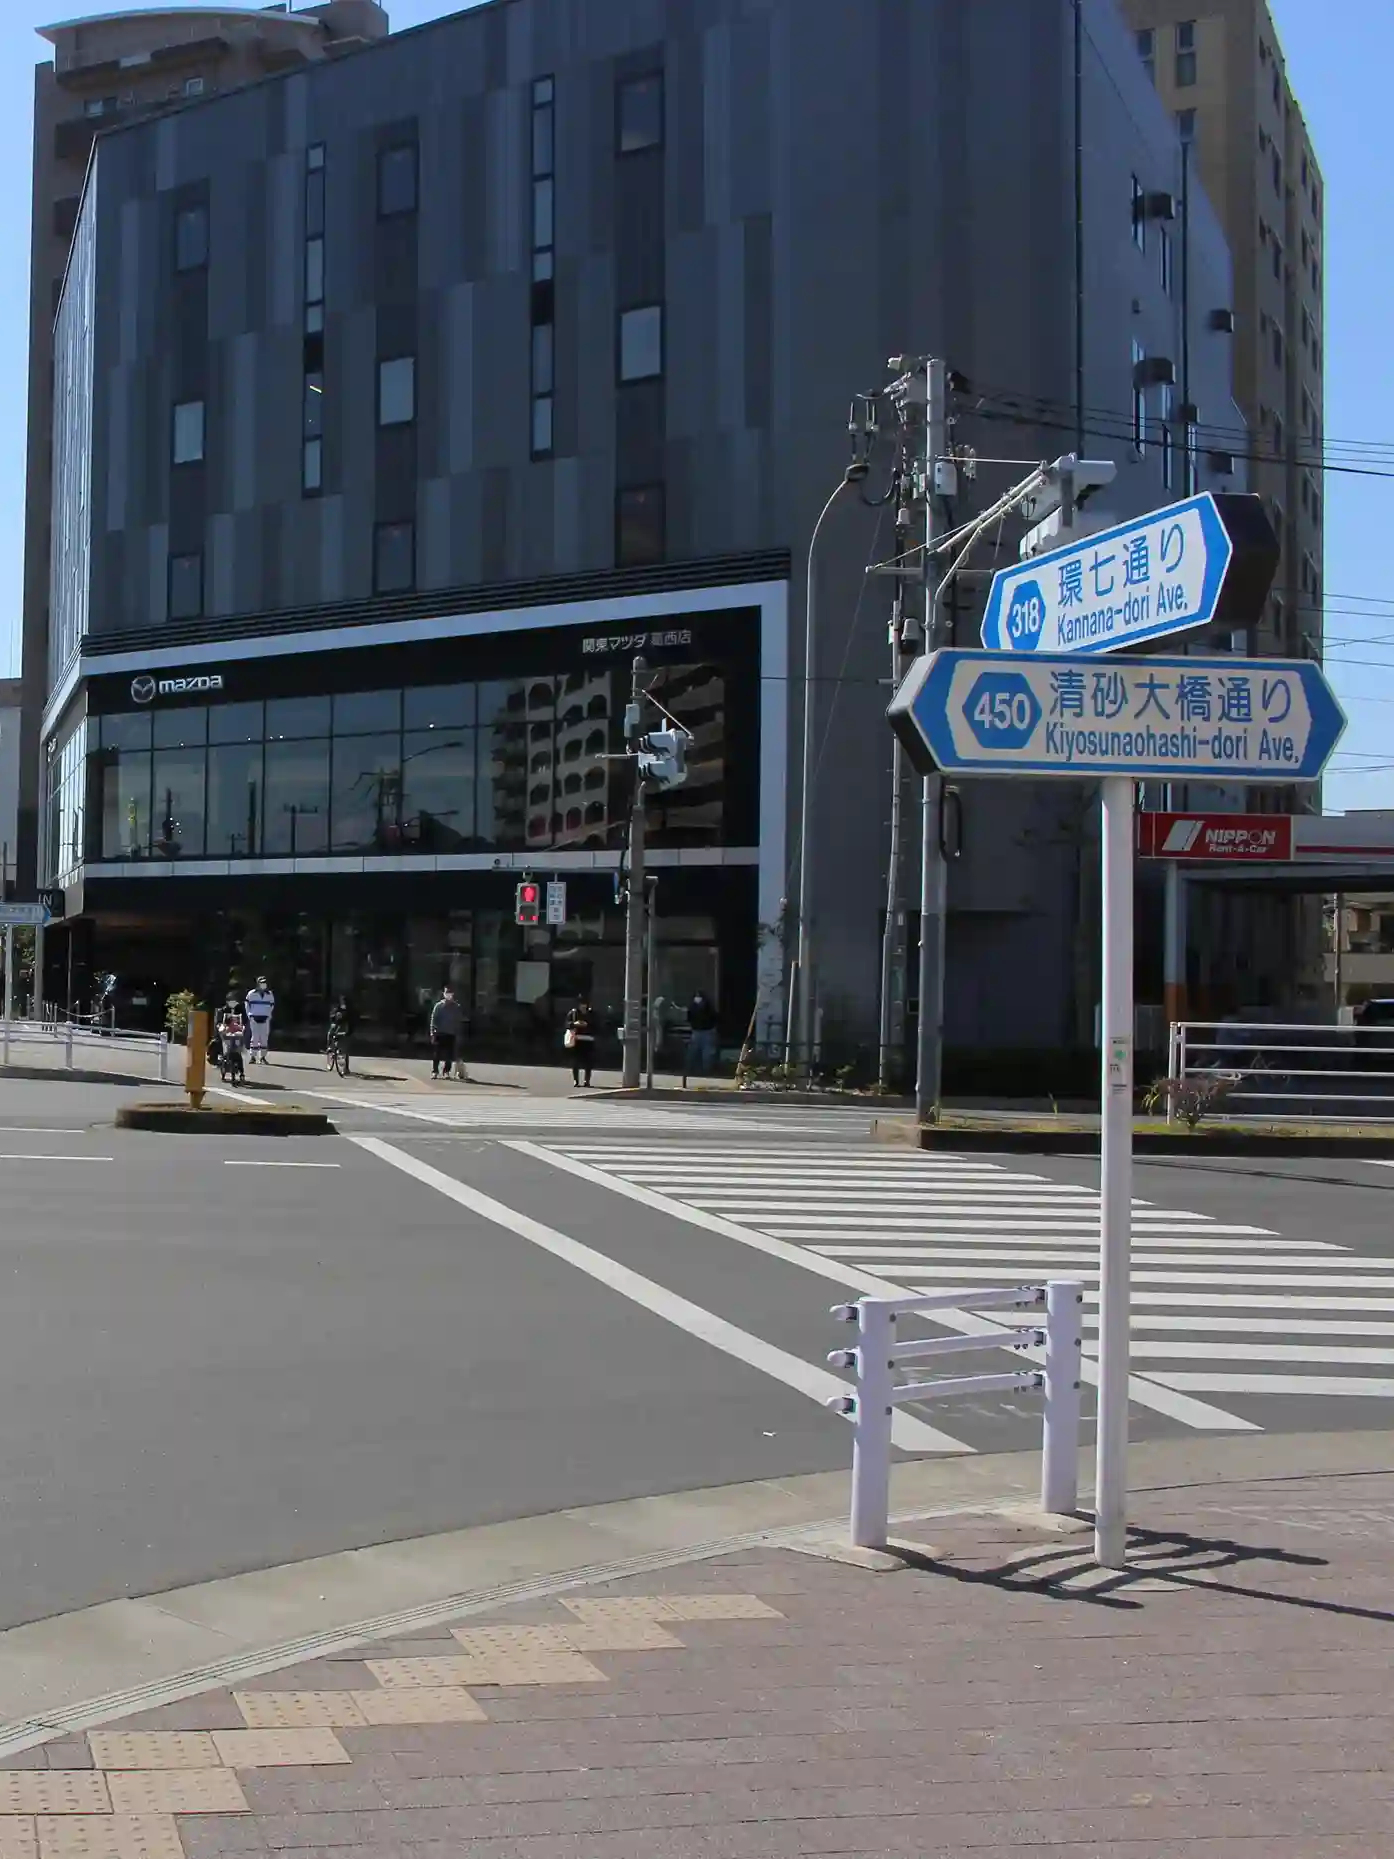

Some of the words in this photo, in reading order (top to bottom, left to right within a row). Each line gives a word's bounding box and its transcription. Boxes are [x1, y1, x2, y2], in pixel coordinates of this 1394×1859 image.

[1058, 523, 1184, 609] 環七通り
[1012, 596, 1040, 638] 318
[1057, 585, 1150, 646] Kannana-dori
[1156, 581, 1188, 616] Ave.
[582, 633, 648, 653] 関東マツダ
[973, 691, 1031, 730] 450
[1049, 669, 1292, 724] 清砂大橋通り
[1046, 721, 1248, 762] Kiyosunaohashi-dori
[1258, 728, 1299, 763] Ave.
[1205, 828, 1277, 845] NIPPON
